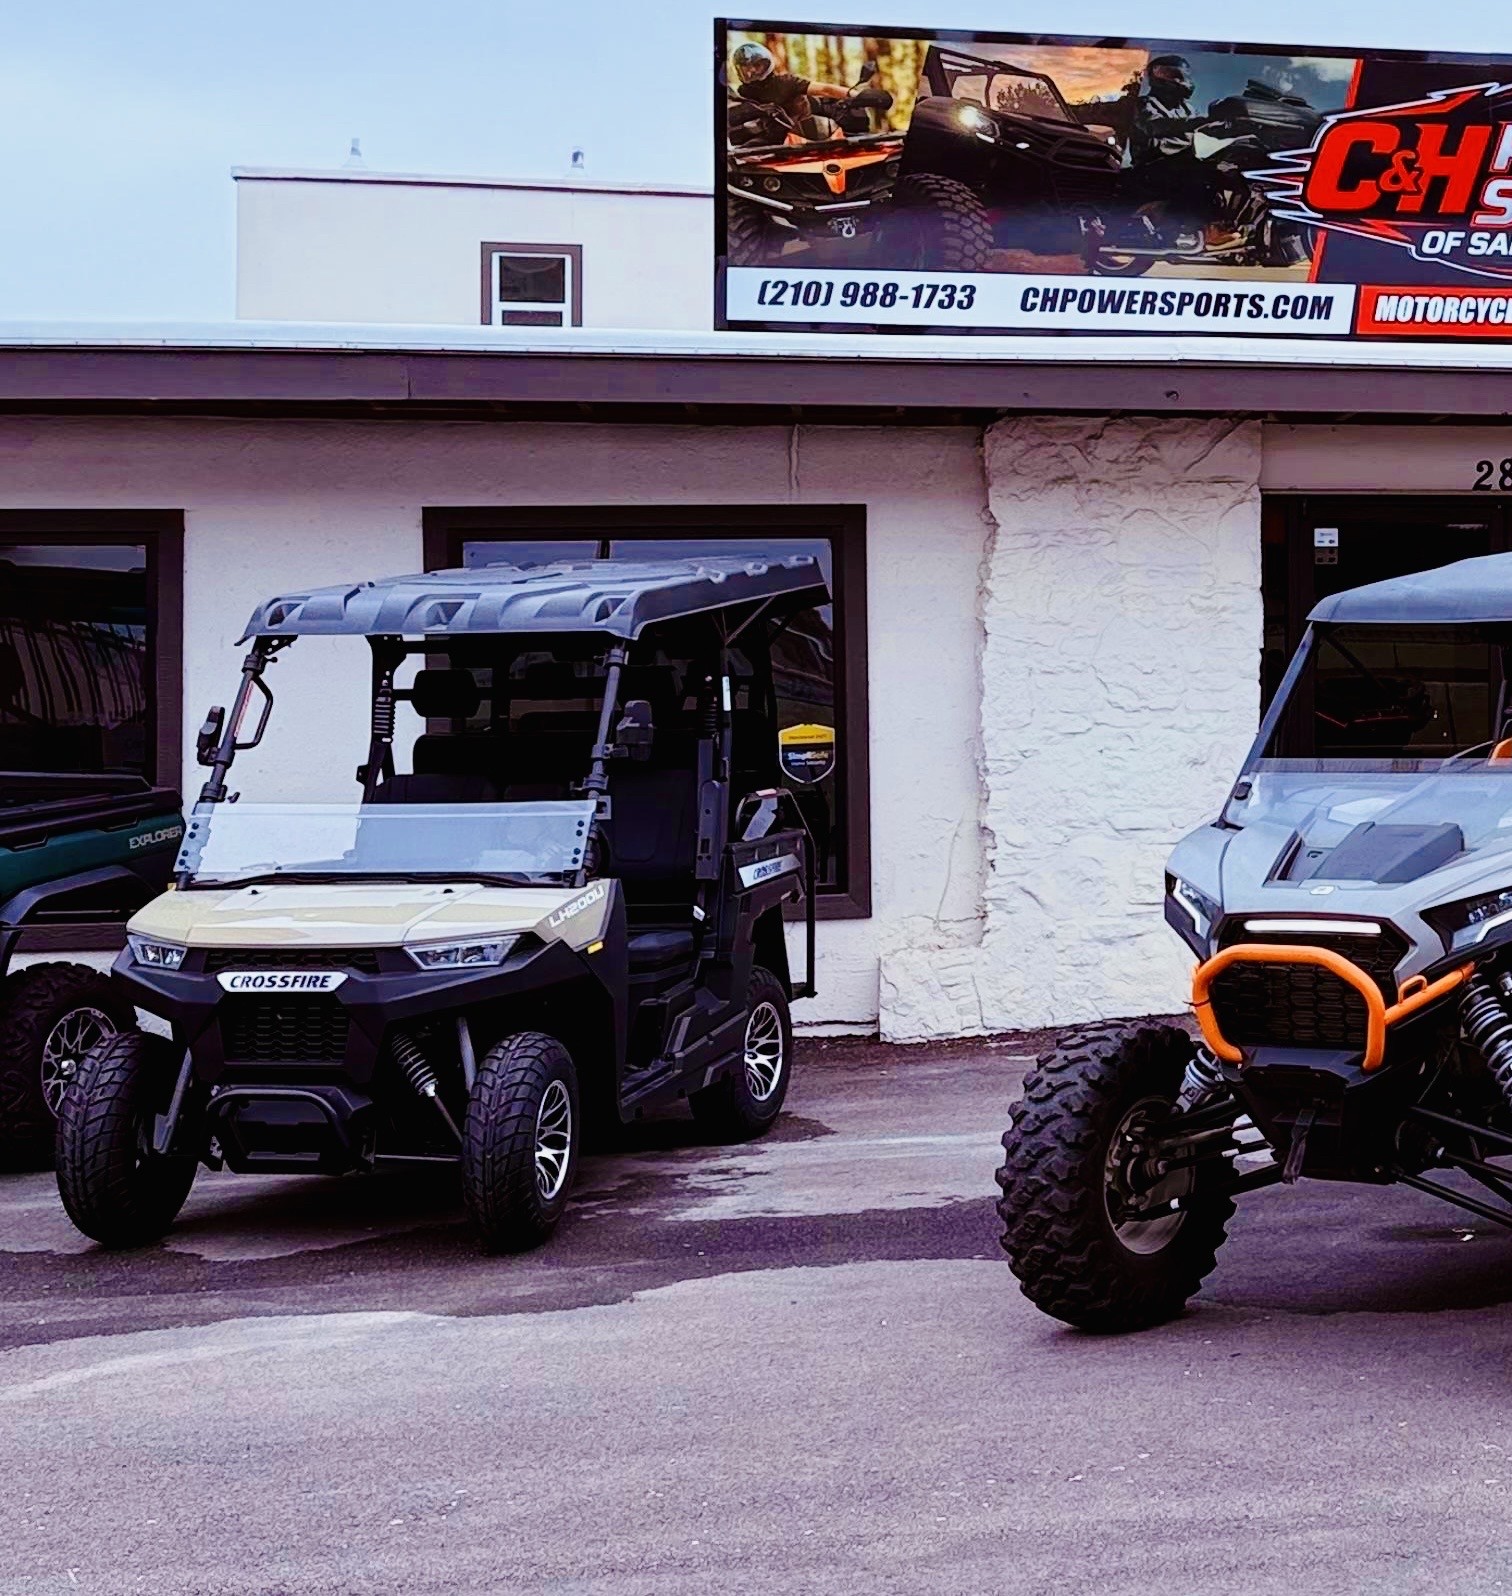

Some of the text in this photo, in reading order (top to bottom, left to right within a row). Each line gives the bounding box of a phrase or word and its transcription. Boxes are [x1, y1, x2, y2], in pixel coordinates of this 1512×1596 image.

[1307, 121, 1492, 213] C&H
[1421, 231, 1465, 255] OF
[757, 280, 977, 310] (210) 988-1733
[1020, 286, 1334, 320] CHPOWERSPORTS.COM
[129, 825, 182, 849] EXPLORER
[230, 975, 331, 988] CROSSFIRE
